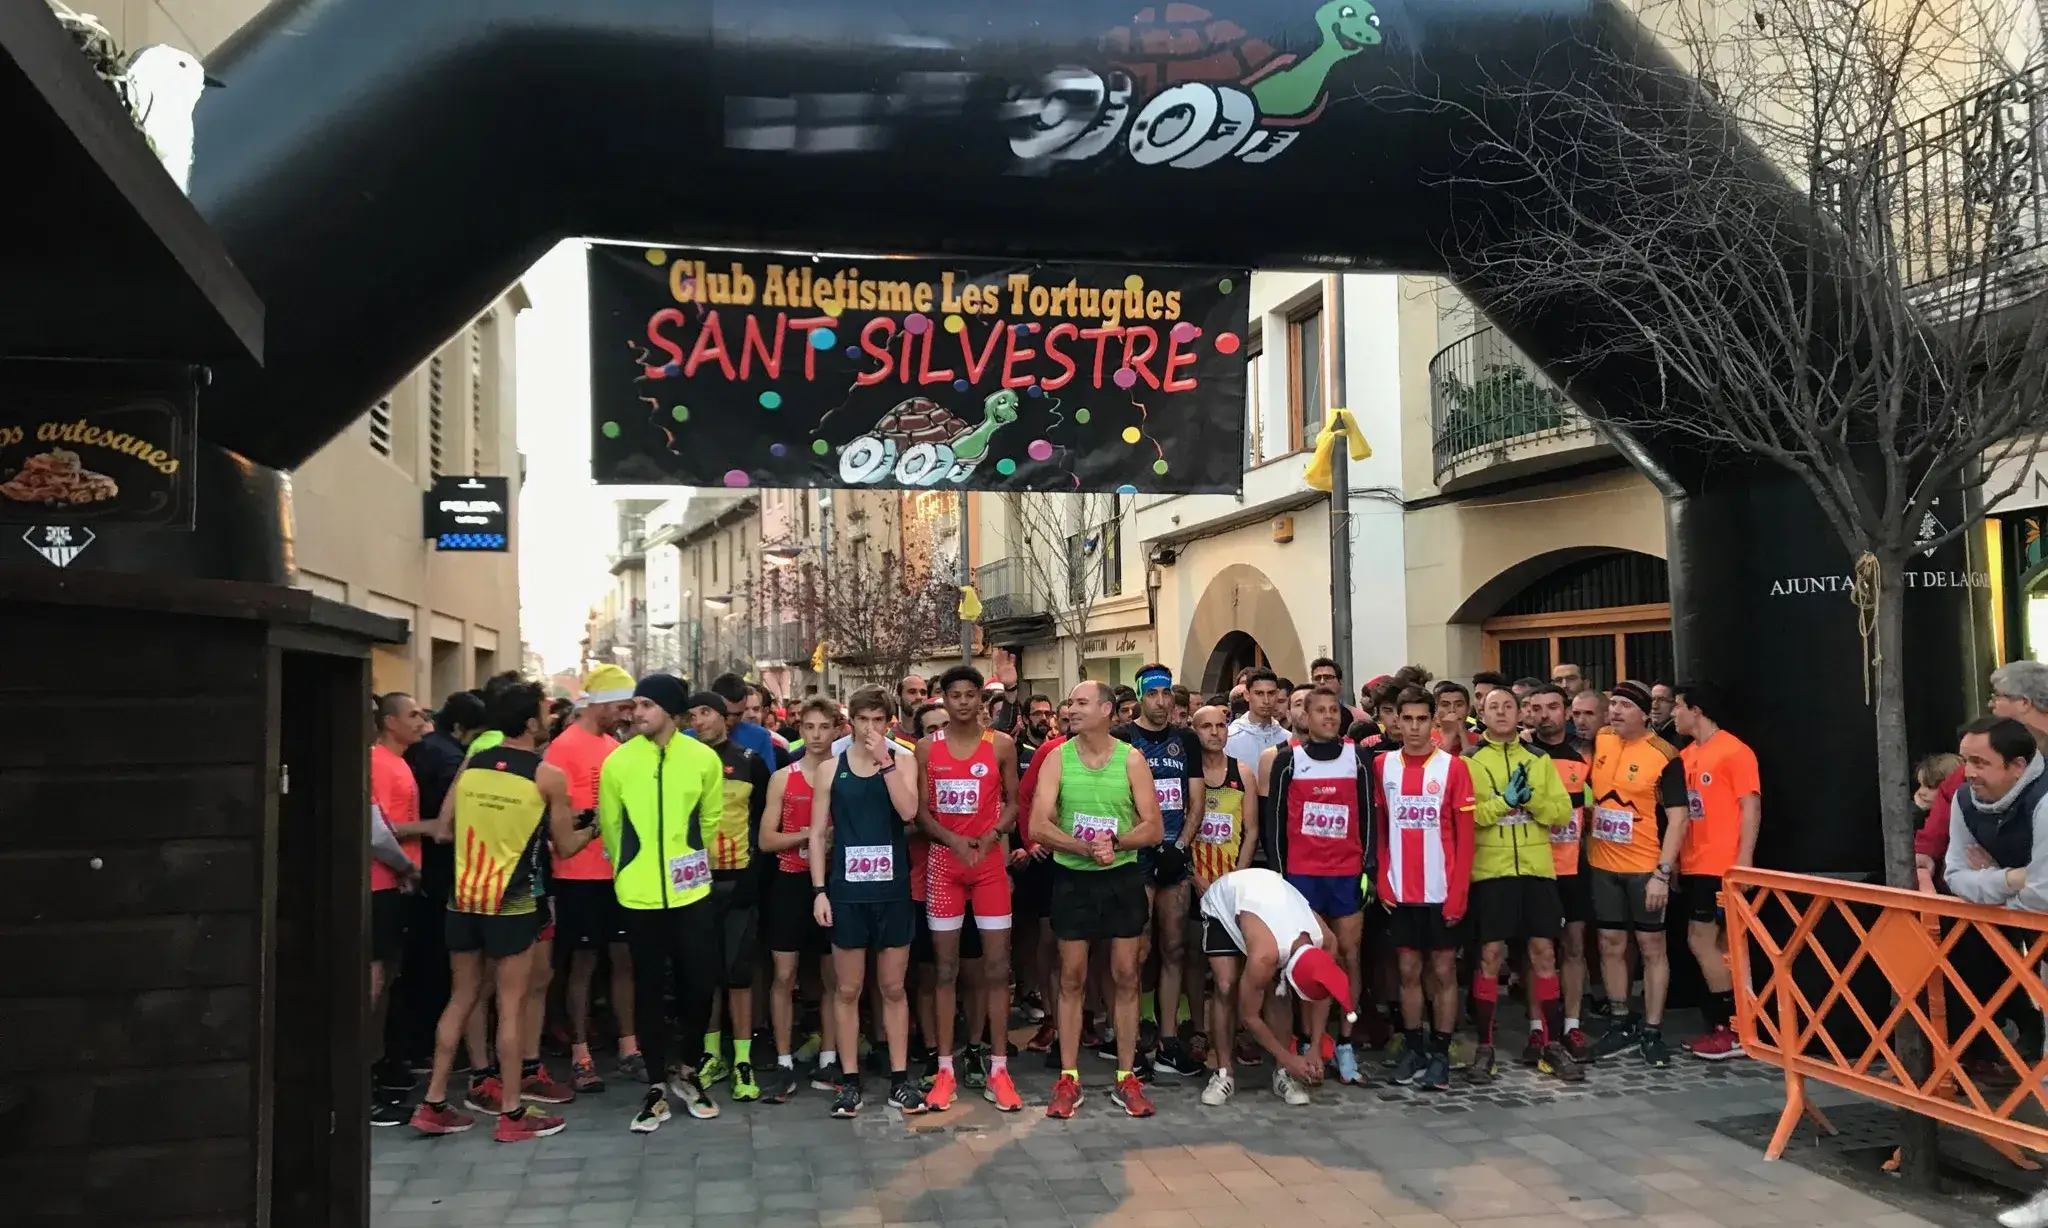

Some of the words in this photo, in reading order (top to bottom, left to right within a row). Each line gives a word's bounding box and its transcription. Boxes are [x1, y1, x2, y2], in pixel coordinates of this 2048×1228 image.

[670, 258, 755, 304] Club
[763, 265, 933, 315] Atletisme
[942, 272, 999, 314] Les
[1008, 274, 1181, 330] Tortugues
[644, 308, 838, 382] SANT
[857, 314, 1203, 393] SILVESTRE
[37, 418, 179, 474] artesanes
[1923, 571, 1947, 587] DE
[1951, 571, 1969, 588] LA
[1162, 757, 1184, 771] SENY
[938, 790, 977, 806] 2019
[1305, 813, 1346, 830] 2019
[1397, 806, 1437, 821] 2019
[1595, 817, 1631, 836] 2019
[672, 861, 708, 884] 2019
[848, 856, 891, 873] 2019
